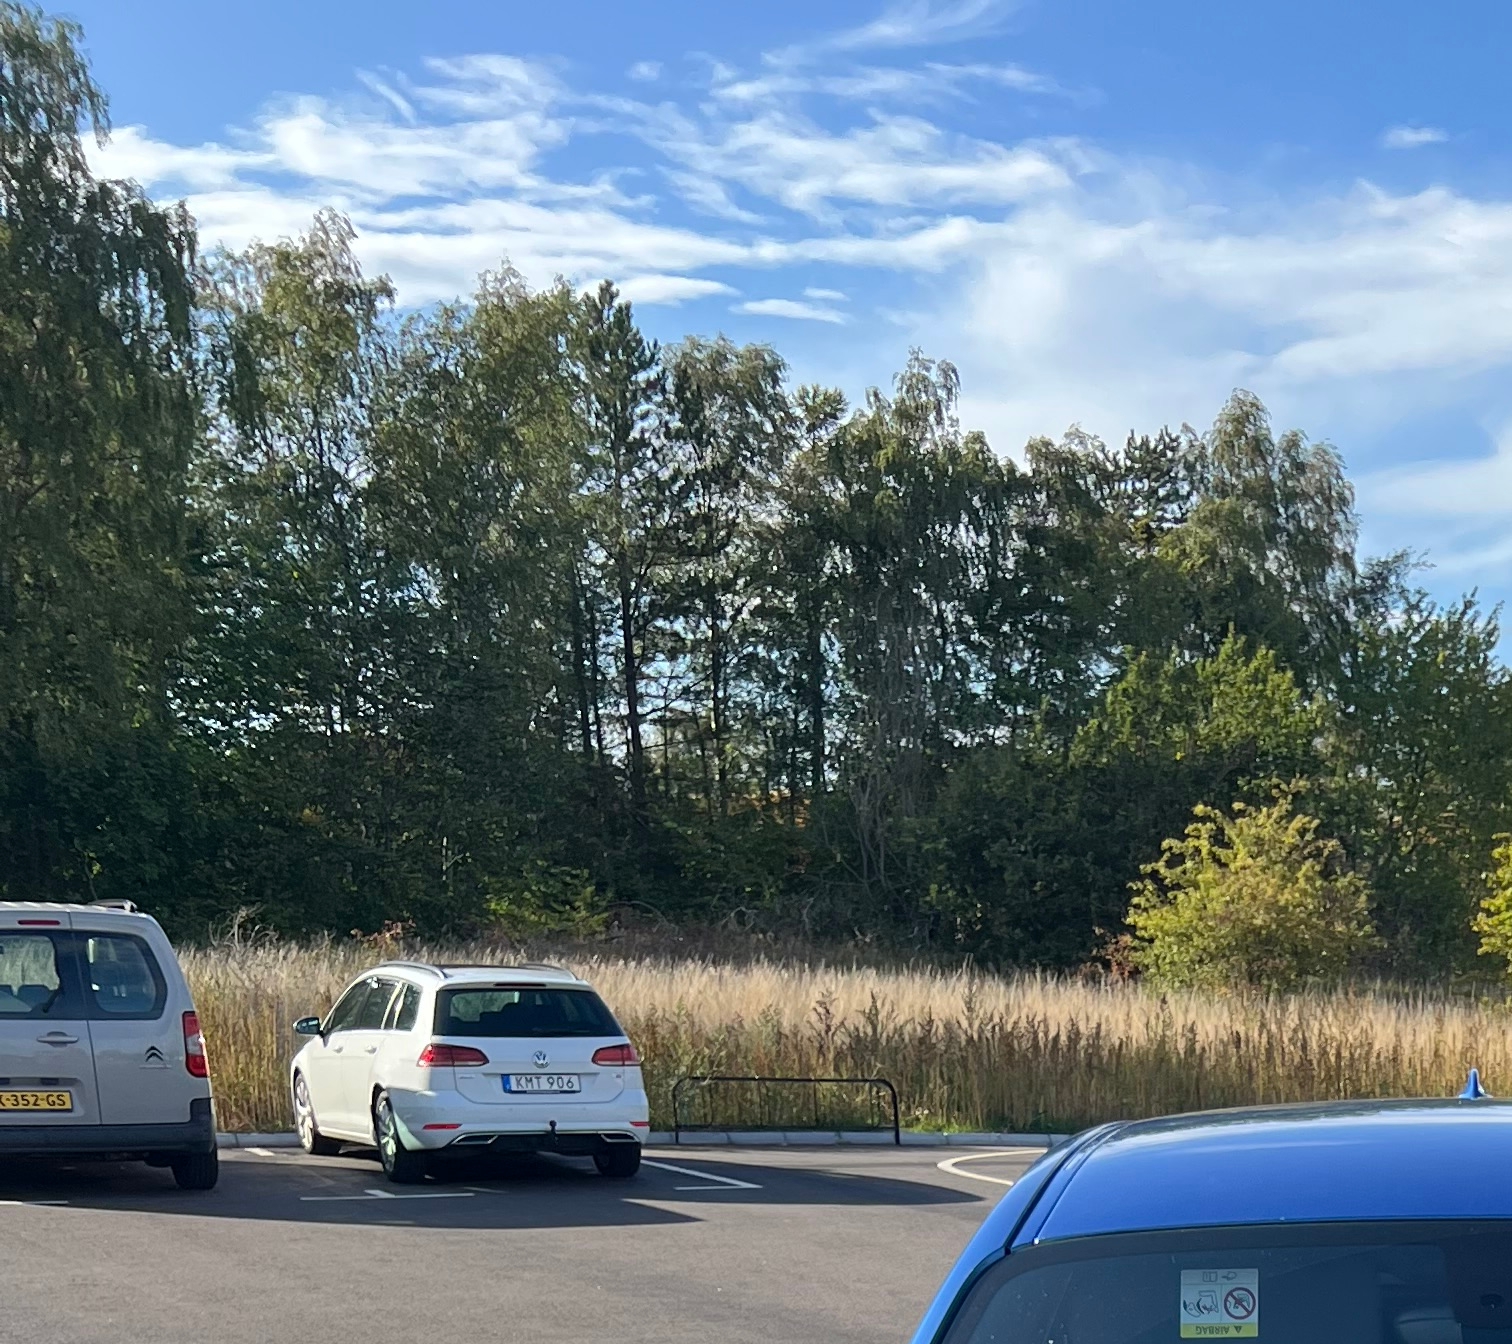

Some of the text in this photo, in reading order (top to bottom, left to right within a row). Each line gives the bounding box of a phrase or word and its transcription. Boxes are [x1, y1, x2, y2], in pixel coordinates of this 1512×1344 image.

[515, 1076, 542, 1090] KMT
[547, 1076, 575, 1089] 906
[1195, 1325, 1231, 1335] AIRBAG
